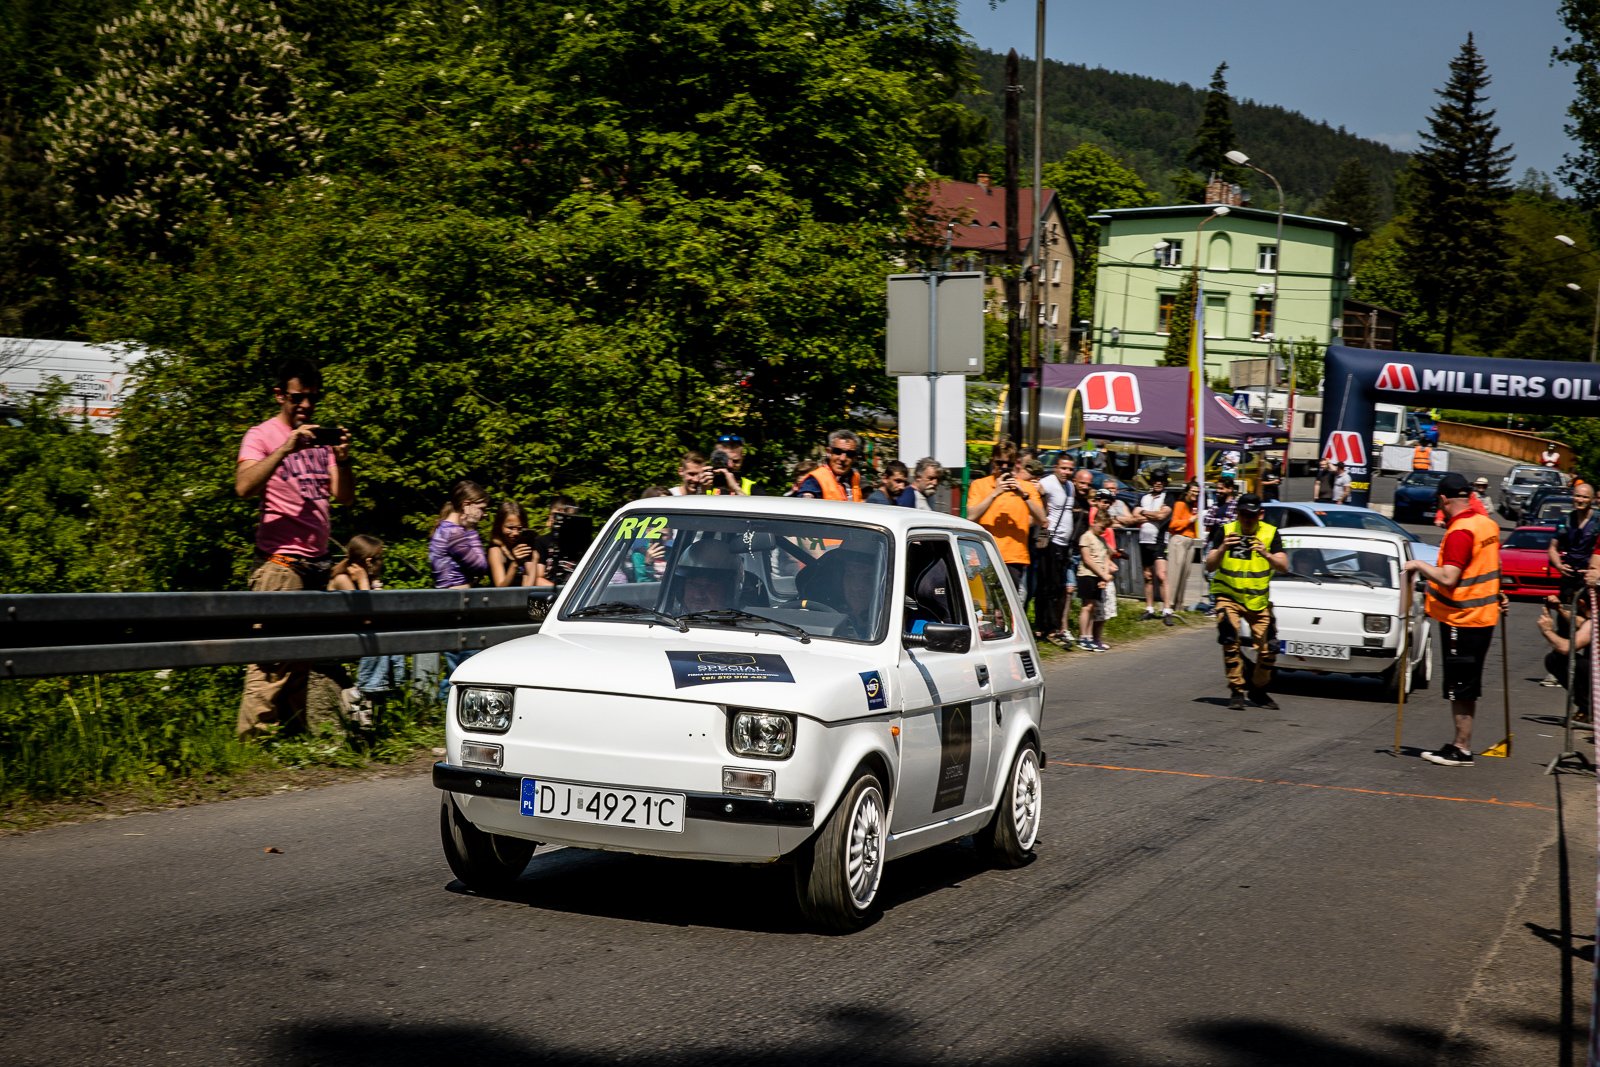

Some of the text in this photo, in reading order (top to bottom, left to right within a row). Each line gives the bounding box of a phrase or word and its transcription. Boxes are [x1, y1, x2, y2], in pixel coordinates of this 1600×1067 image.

[1422, 369, 1600, 400] MILLERS OIL
[1108, 415, 1141, 424] OILS
[615, 516, 668, 540] R12
[1288, 642, 1347, 658] DB 5353K
[697, 664, 765, 673] SPECIAL
[523, 800, 533, 810] PL
[539, 785, 676, 827] DJ 4921C
